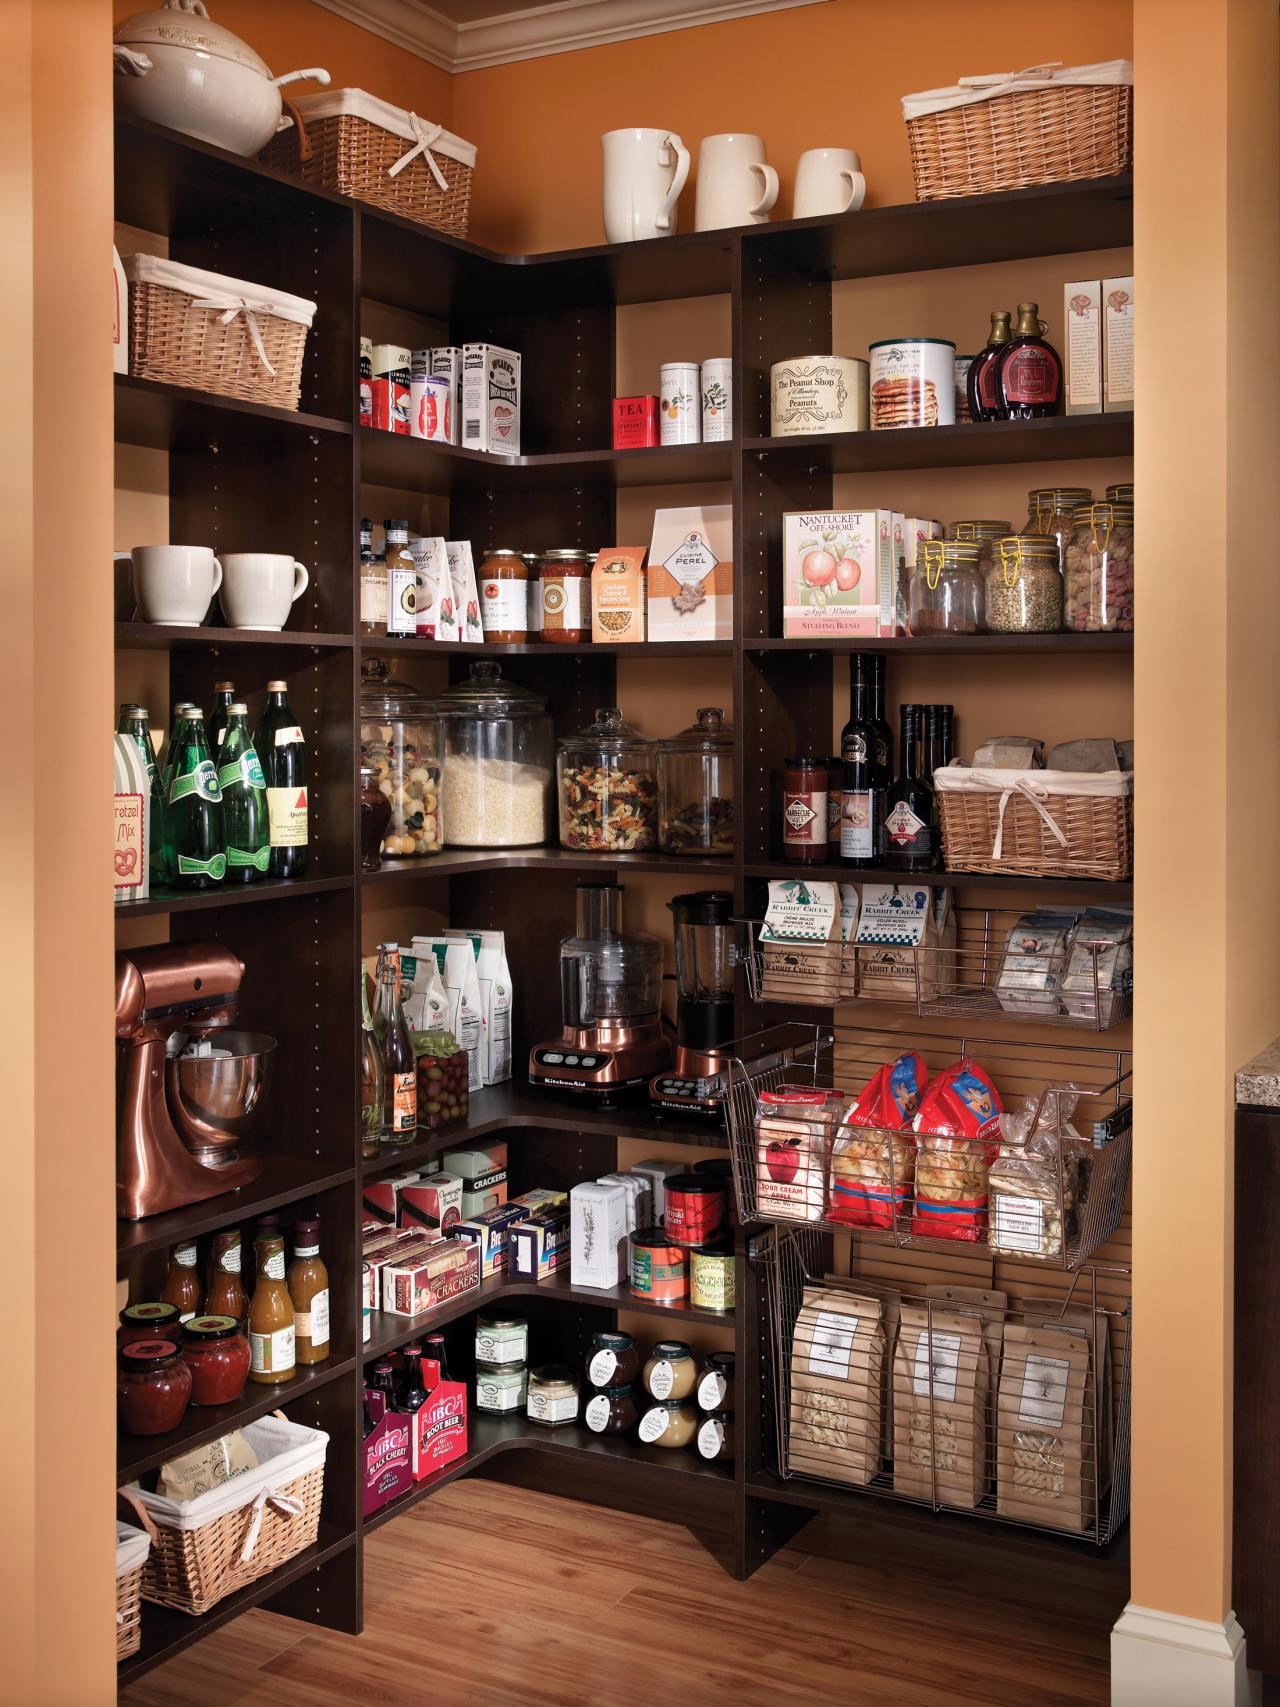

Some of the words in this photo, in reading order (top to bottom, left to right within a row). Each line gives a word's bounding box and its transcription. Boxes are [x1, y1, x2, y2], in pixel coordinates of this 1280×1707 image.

[778, 380, 789, 390] The
[789, 379, 813, 388] Peanut
[814, 378, 835, 387] Shop
[619, 403, 644, 417] TEA
[789, 399, 818, 408] Peanuts
[799, 514, 862, 528] NANTUCKET
[675, 557, 707, 565] PEREL
[801, 620, 836, 630] STUFFING
[836, 621, 861, 631] BLEND
[115, 804, 139, 819] retzel
[117, 823, 135, 842] Mix
[865, 906, 894, 915] RABBIT
[863, 963, 890, 972] RABBIT
[890, 965, 917, 974] CREEK
[544, 1077, 586, 1088] KitchenAid
[661, 1100, 701, 1111] KitchenAid
[473, 1171, 508, 1190] CRACKERS
[779, 1186, 803, 1195] CREAM
[436, 1271, 479, 1300] CRACKERS
[432, 1402, 454, 1423] IBC
[426, 1422, 445, 1440] ROOT
[444, 1415, 460, 1427] BEER
[378, 1435, 400, 1457] IBC
[369, 1457, 386, 1476] BLACK
[385, 1447, 407, 1462] CHERRY
